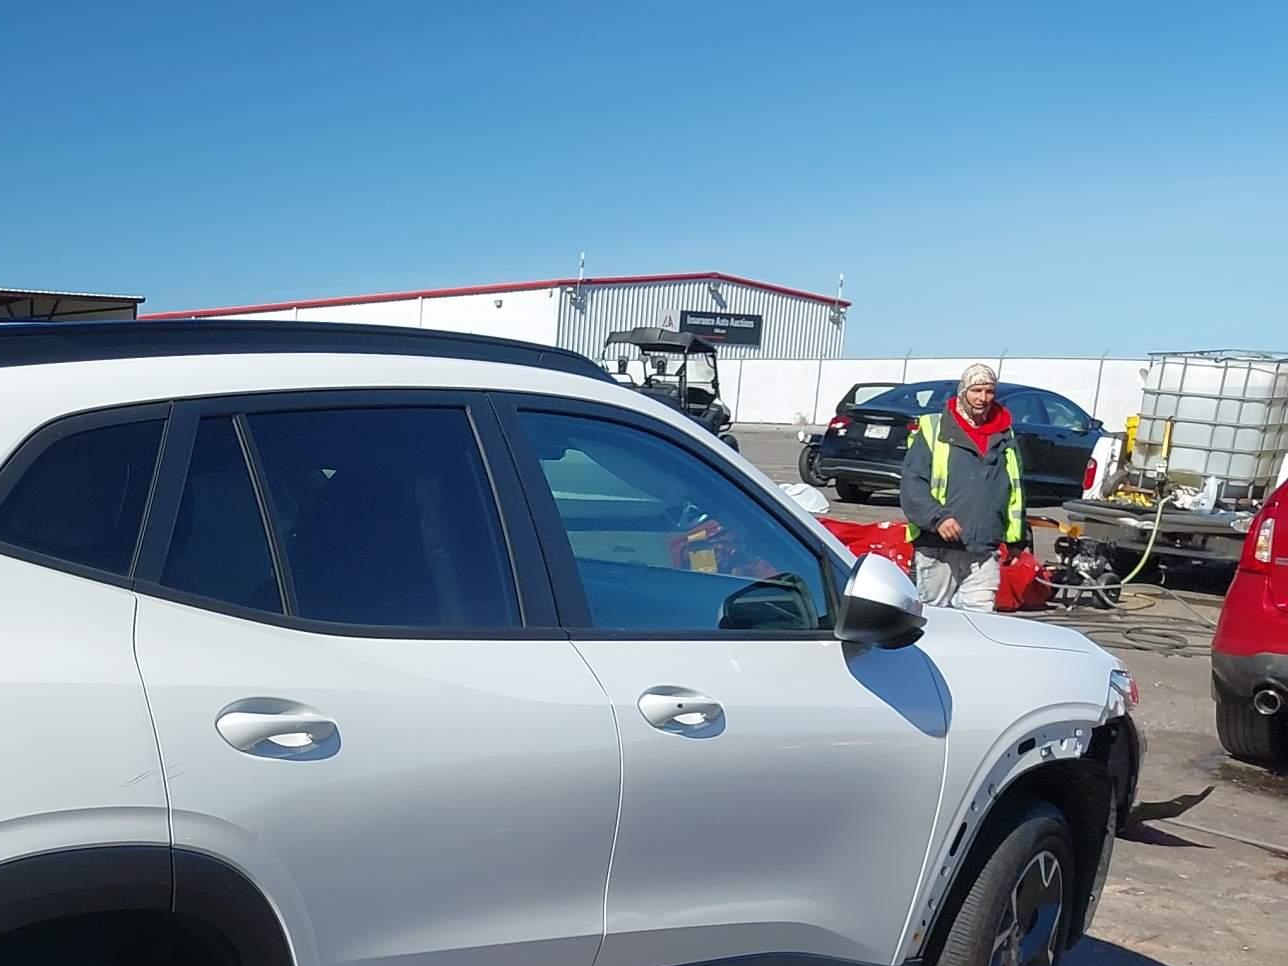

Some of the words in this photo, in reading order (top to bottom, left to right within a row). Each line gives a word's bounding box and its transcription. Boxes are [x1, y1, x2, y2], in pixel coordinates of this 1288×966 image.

[686, 314, 715, 326] Insurance
[715, 316, 729, 327] Auto
[729, 317, 754, 328] Auctions
